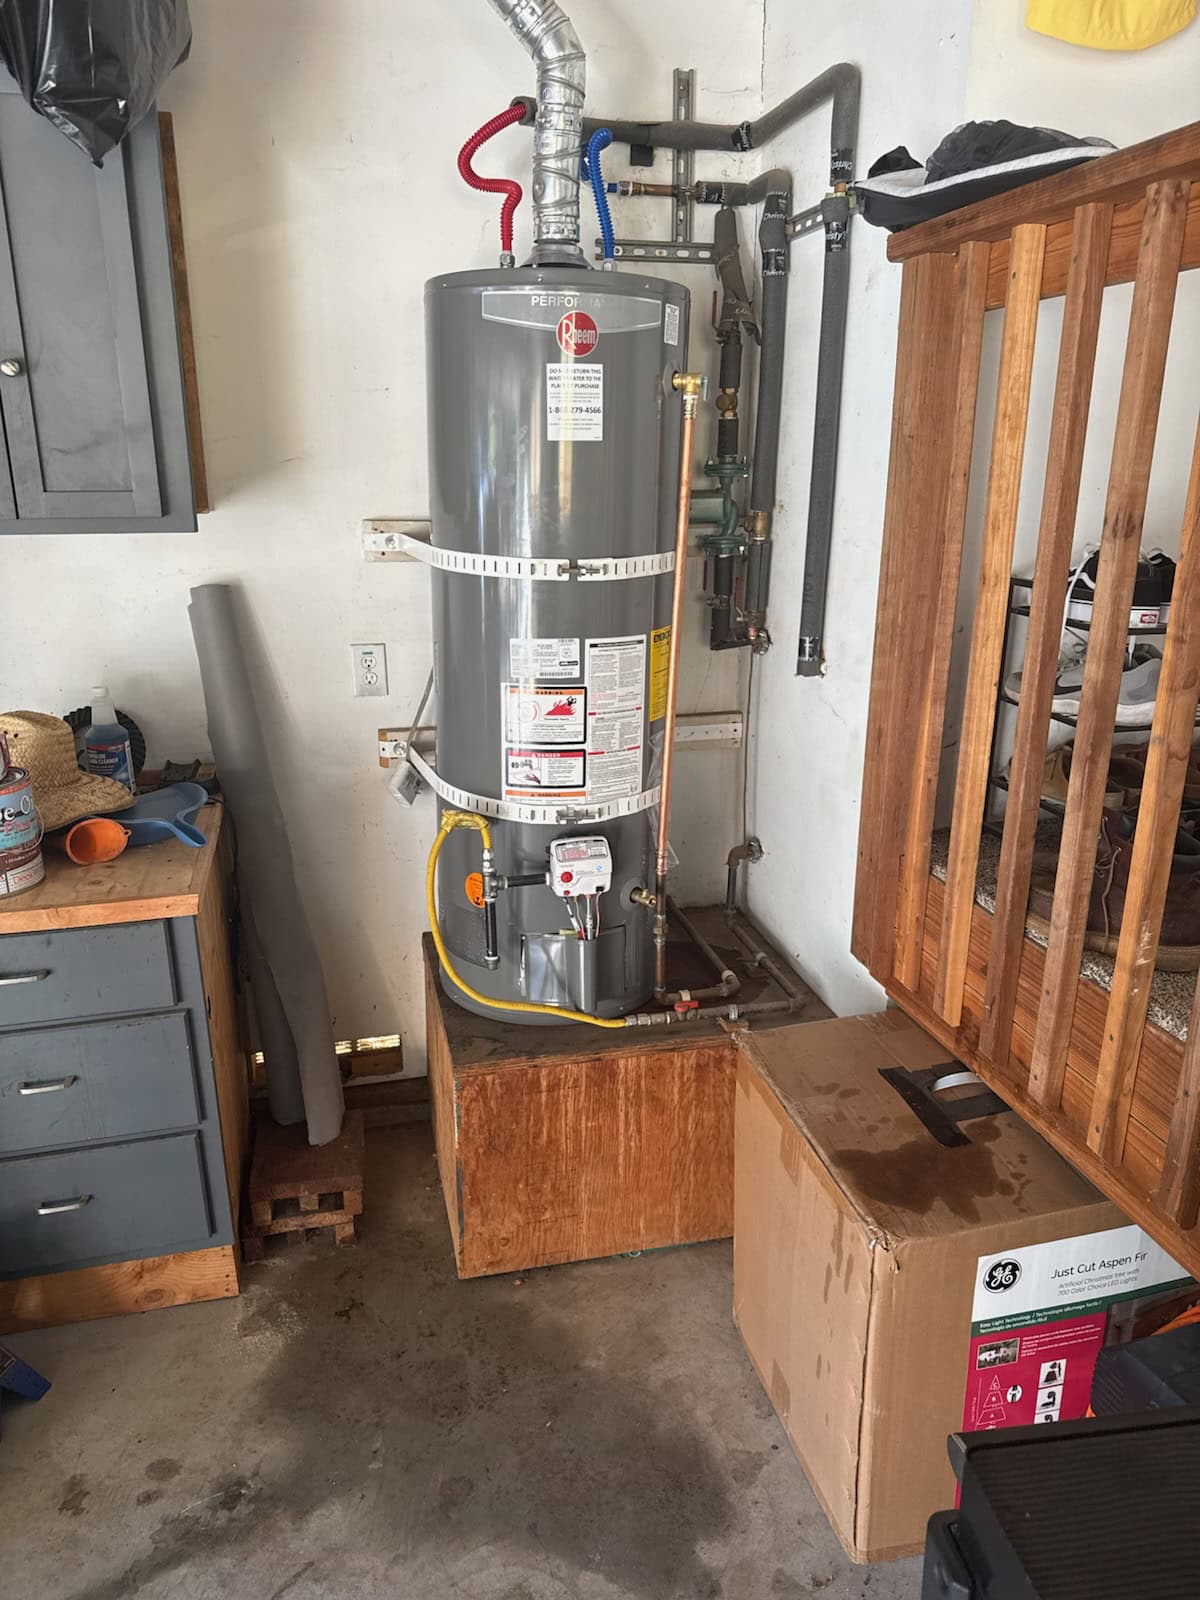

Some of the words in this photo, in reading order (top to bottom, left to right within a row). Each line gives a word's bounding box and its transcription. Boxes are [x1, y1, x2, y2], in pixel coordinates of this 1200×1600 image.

[562, 312, 596, 349] Rheem
[1051, 1266, 1074, 1280] Just
[1077, 1262, 1096, 1275] Cut
[1099, 1256, 1132, 1272] Aspen
[1135, 1251, 1148, 1262] Fir
